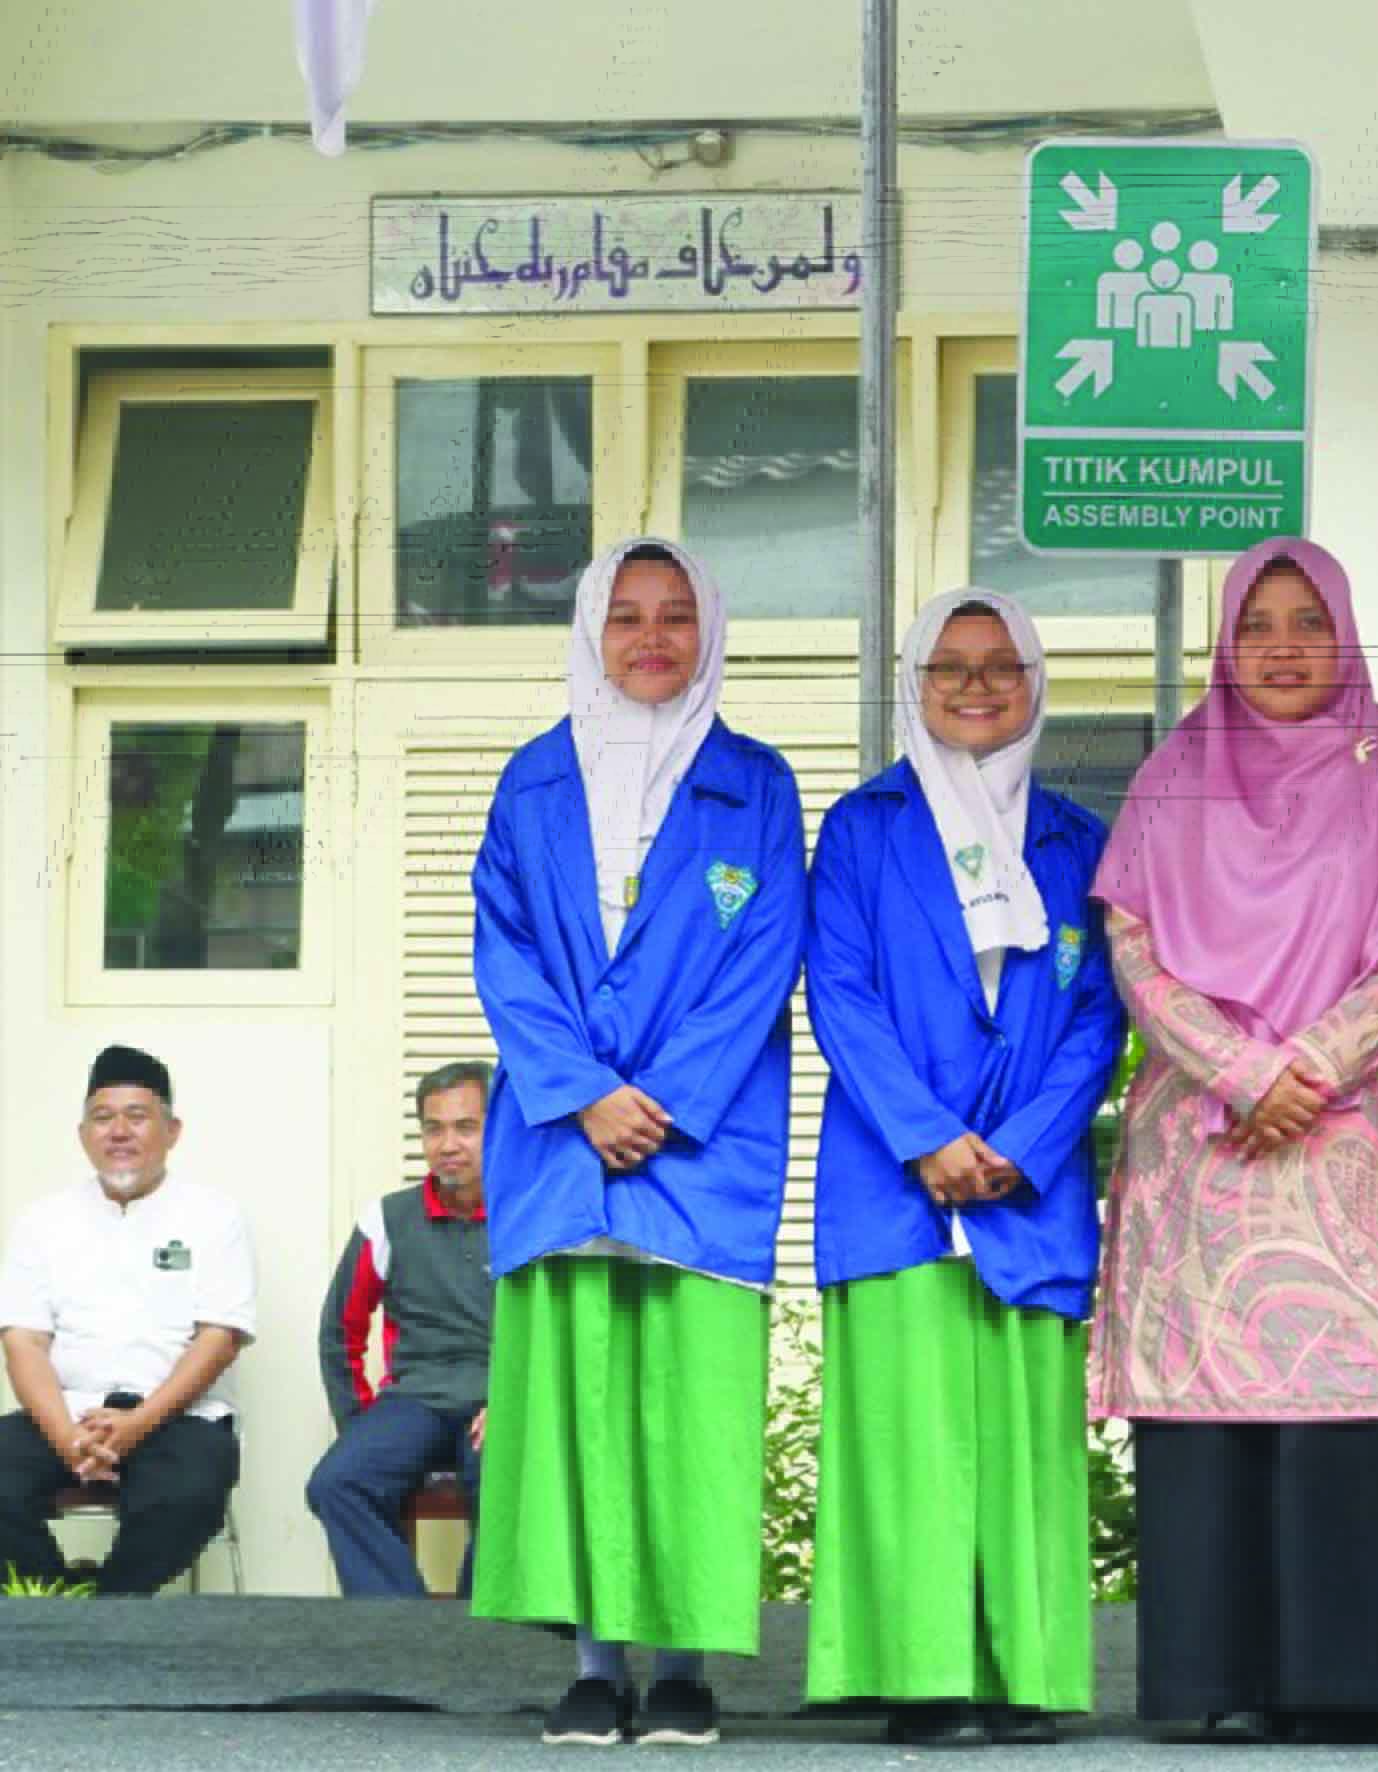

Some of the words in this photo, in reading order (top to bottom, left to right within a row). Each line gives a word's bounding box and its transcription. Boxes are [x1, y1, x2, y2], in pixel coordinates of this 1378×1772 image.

[1043, 456, 1129, 484] TITIK
[1139, 456, 1284, 486] KUMPUL
[1042, 504, 1193, 528] ASSEMBLY
[1200, 506, 1284, 529] POINT
